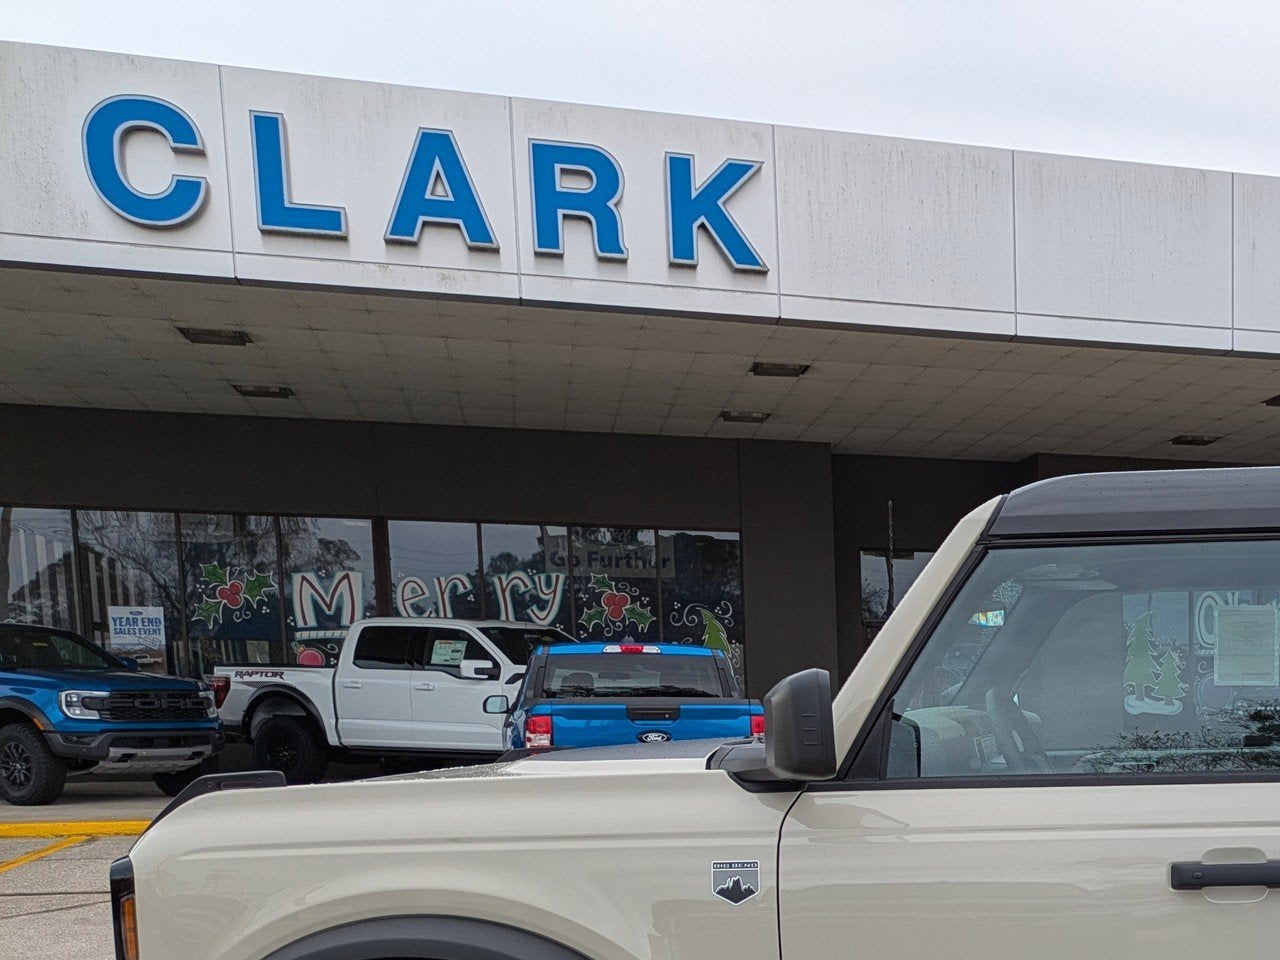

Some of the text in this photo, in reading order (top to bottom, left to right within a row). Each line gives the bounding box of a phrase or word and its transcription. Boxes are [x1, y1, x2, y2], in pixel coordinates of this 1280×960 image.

[81, 92, 770, 274] CLARK
[291, 570, 567, 629] Merry
[111, 616, 162, 628] YEAR END
[113, 627, 162, 636] SALES EVENT
[234, 670, 286, 681] RAPTOR
[105, 698, 210, 710] FORD
